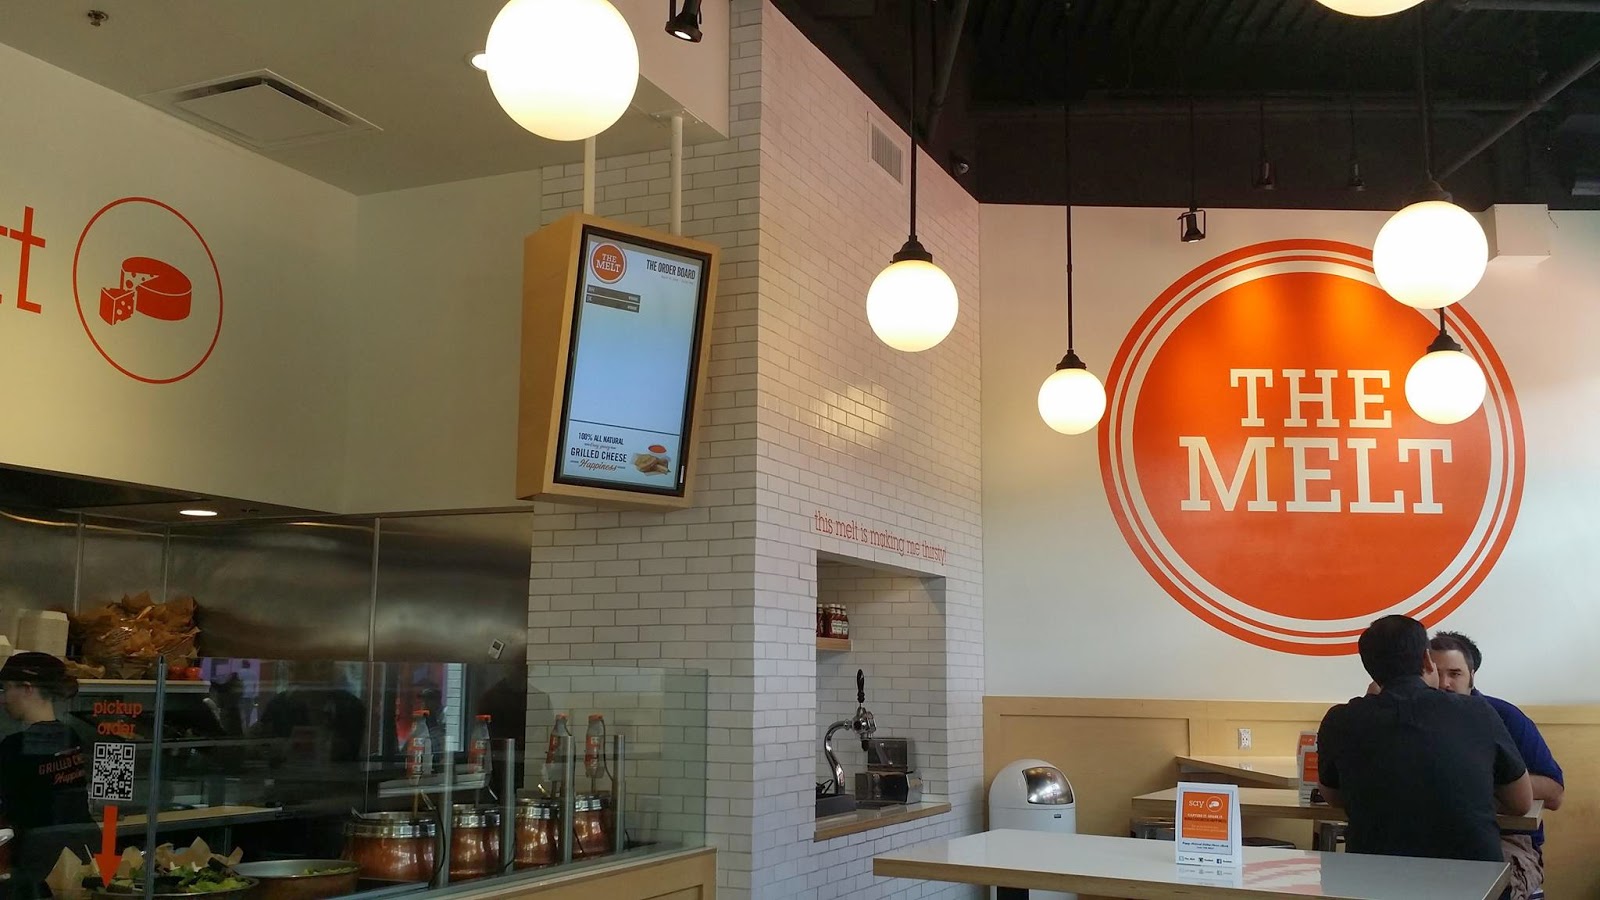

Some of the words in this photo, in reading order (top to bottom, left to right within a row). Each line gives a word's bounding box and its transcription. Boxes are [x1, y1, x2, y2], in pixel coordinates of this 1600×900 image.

[595, 259, 621, 273] MELT
[602, 253, 617, 263] THE
[646, 259, 658, 273] THE
[657, 262, 676, 276] ORDER
[676, 265, 696, 280] BOARD
[1230, 368, 1392, 428] THE
[578, 432, 593, 442] 100%
[593, 434, 603, 443] ALL
[603, 435, 624, 445] NATURAL
[570, 447, 600, 459] GRILLED
[601, 451, 628, 463] CHEESE
[578, 459, 618, 472] Happiness
[1179, 436, 1453, 514] MELT
[814, 509, 834, 535] this
[835, 520, 859, 541] melt
[860, 523, 868, 543] is
[870, 530, 905, 556] making
[906, 540, 920, 556] me
[92, 700, 143, 718] pickup
[97, 719, 136, 738] order
[1188, 800, 1205, 808] say
